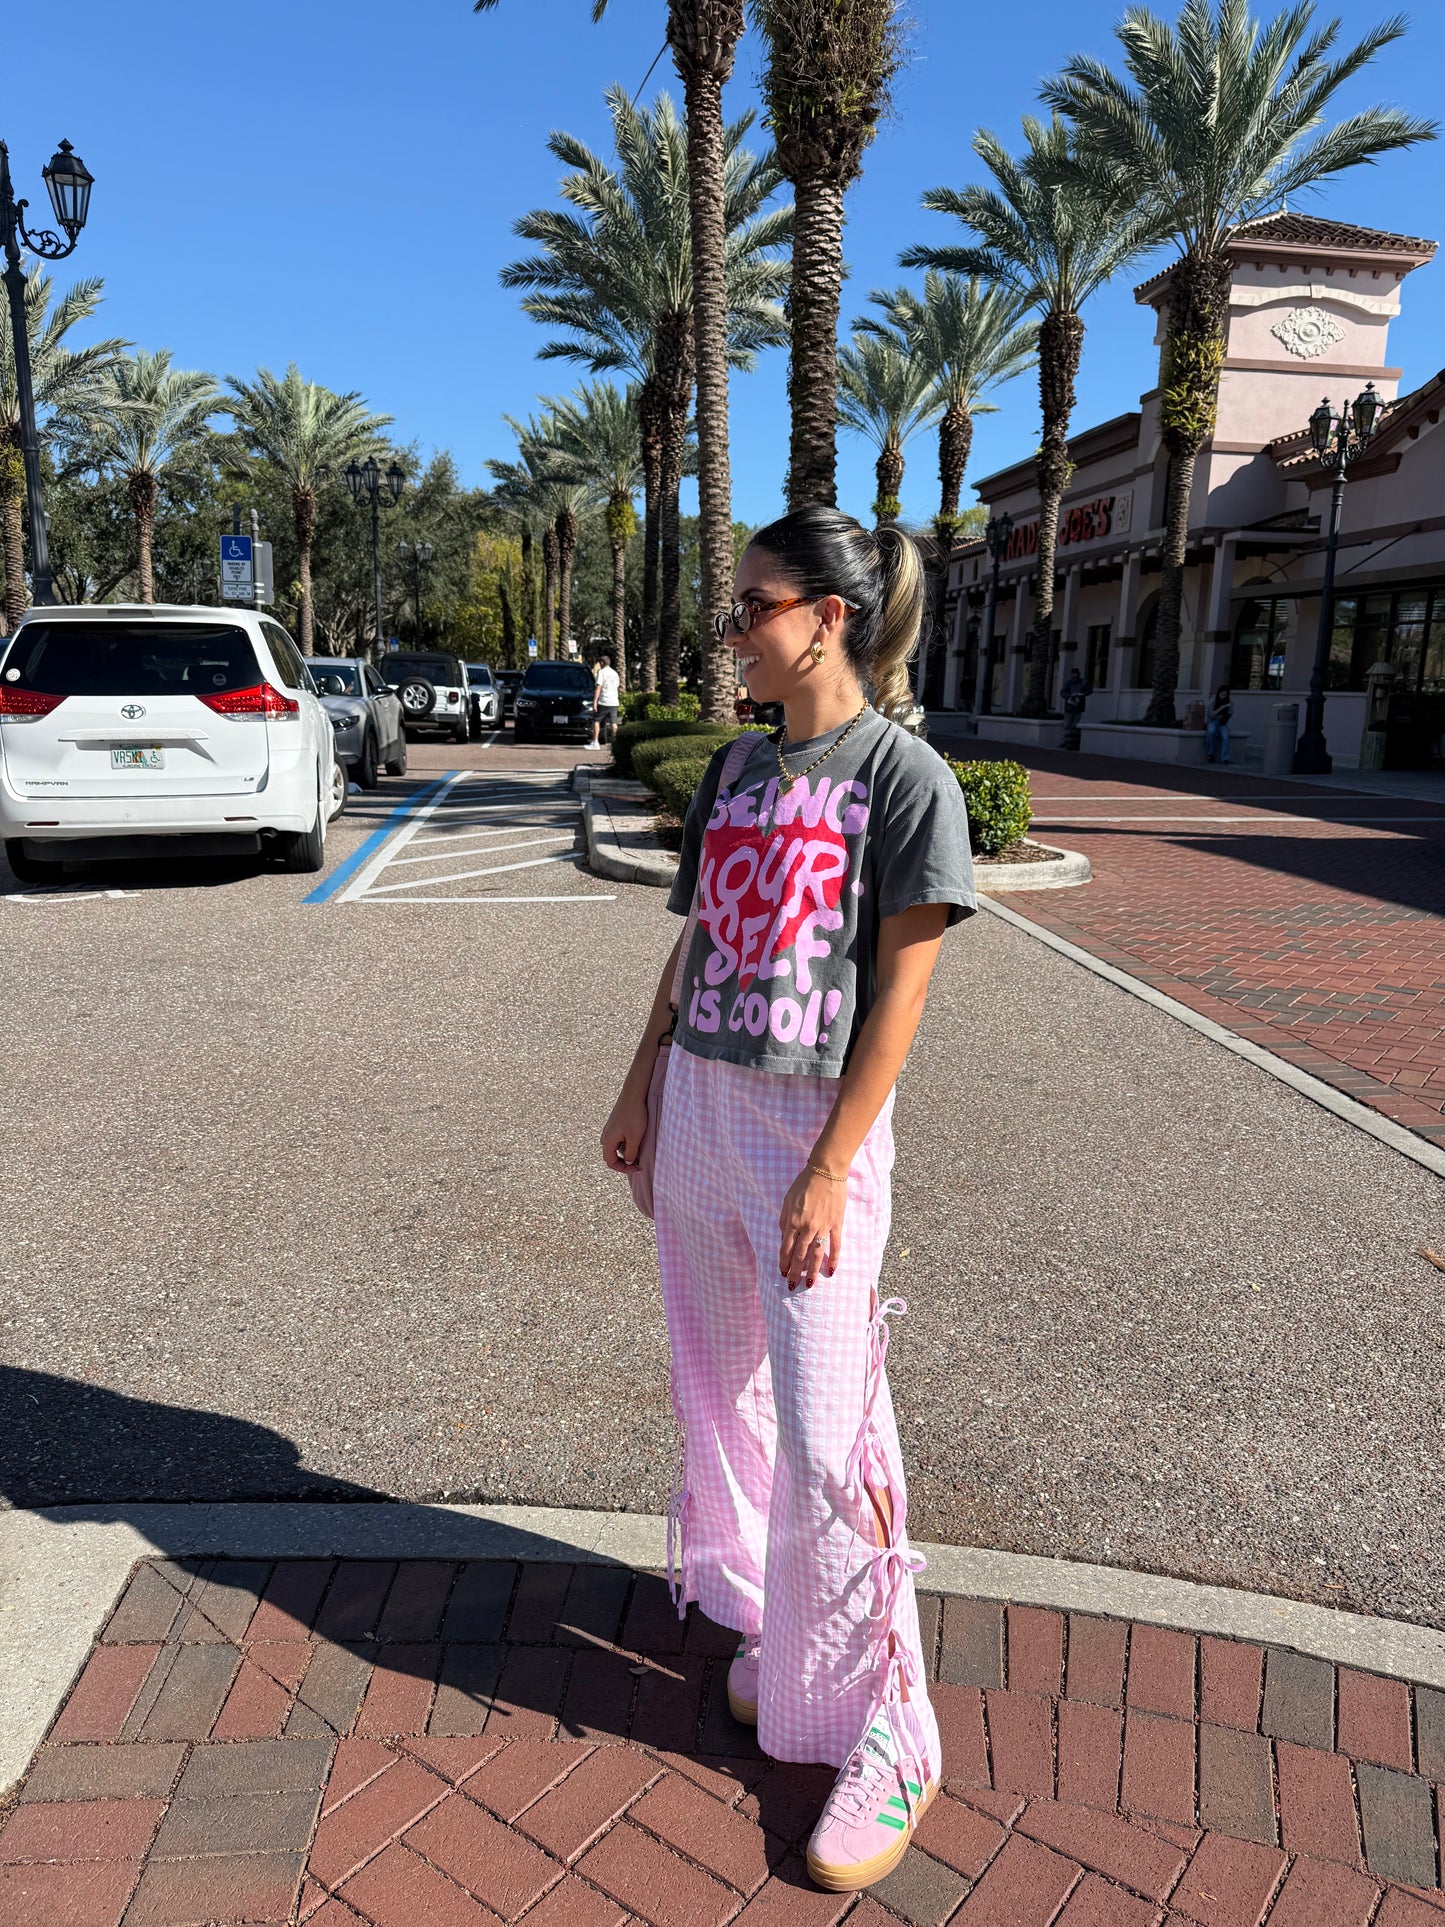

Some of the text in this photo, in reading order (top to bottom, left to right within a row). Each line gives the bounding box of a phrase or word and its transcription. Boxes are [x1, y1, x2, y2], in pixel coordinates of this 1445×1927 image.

[1059, 498, 1114, 545] JOE'S
[706, 775, 869, 834] BEING
[699, 834, 848, 919] YOUR
[704, 903, 844, 994] SELF
